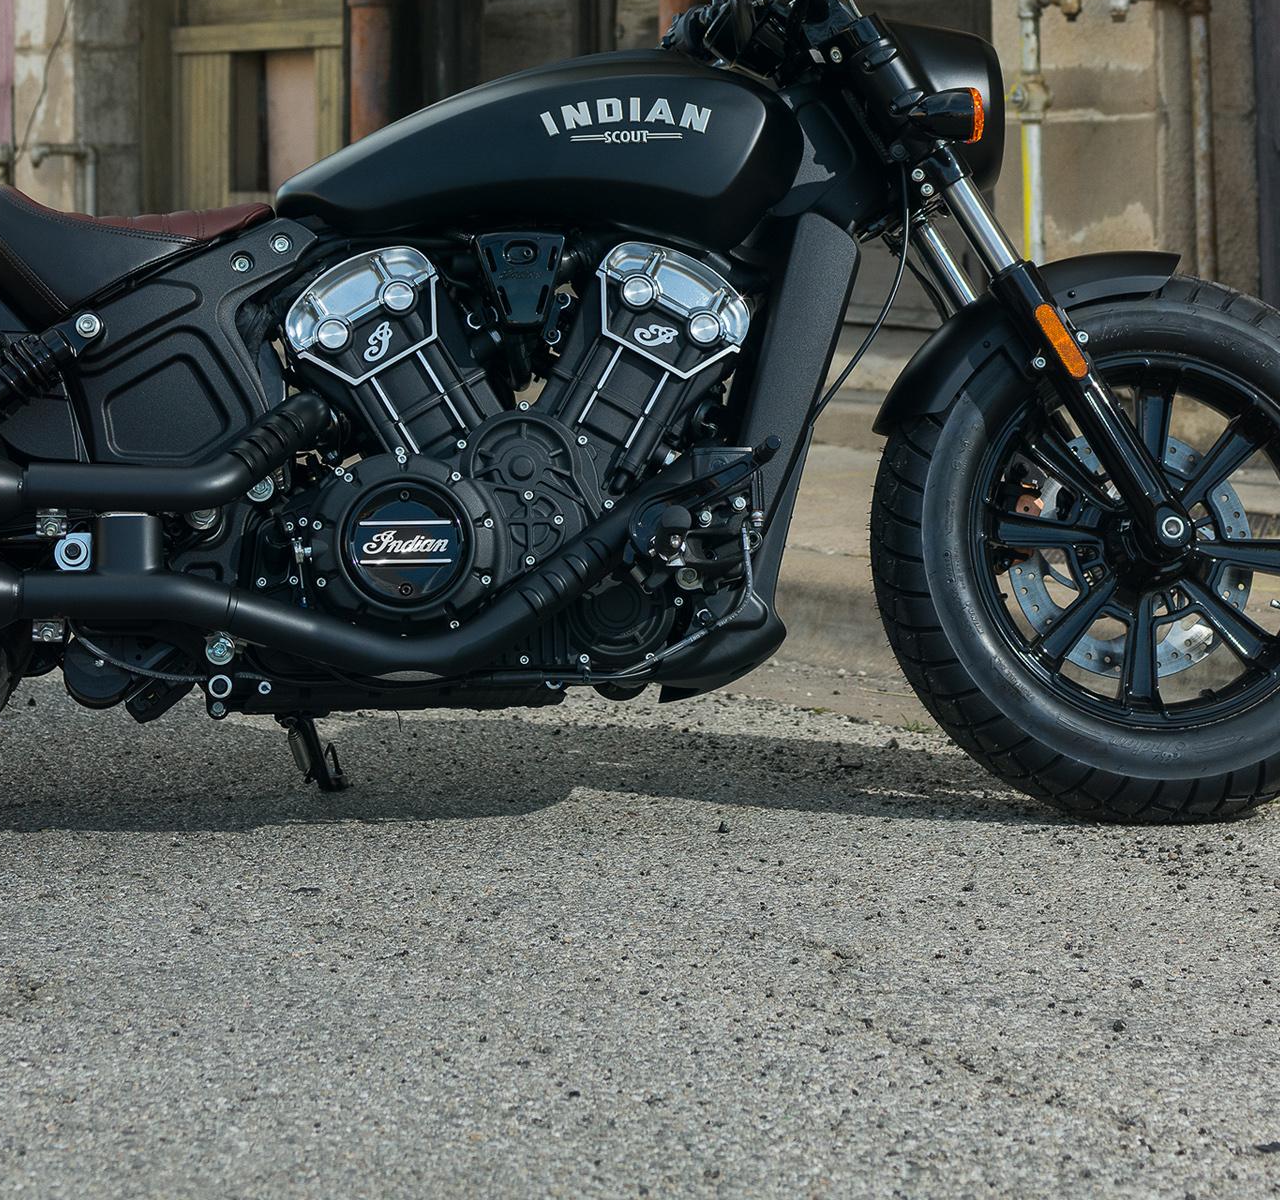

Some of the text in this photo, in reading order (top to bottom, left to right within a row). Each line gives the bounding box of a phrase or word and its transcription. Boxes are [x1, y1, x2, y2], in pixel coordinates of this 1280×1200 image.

[539, 97, 712, 137] INDIAN
[604, 130, 649, 143] SCOUT
[362, 530, 449, 554] Indian
